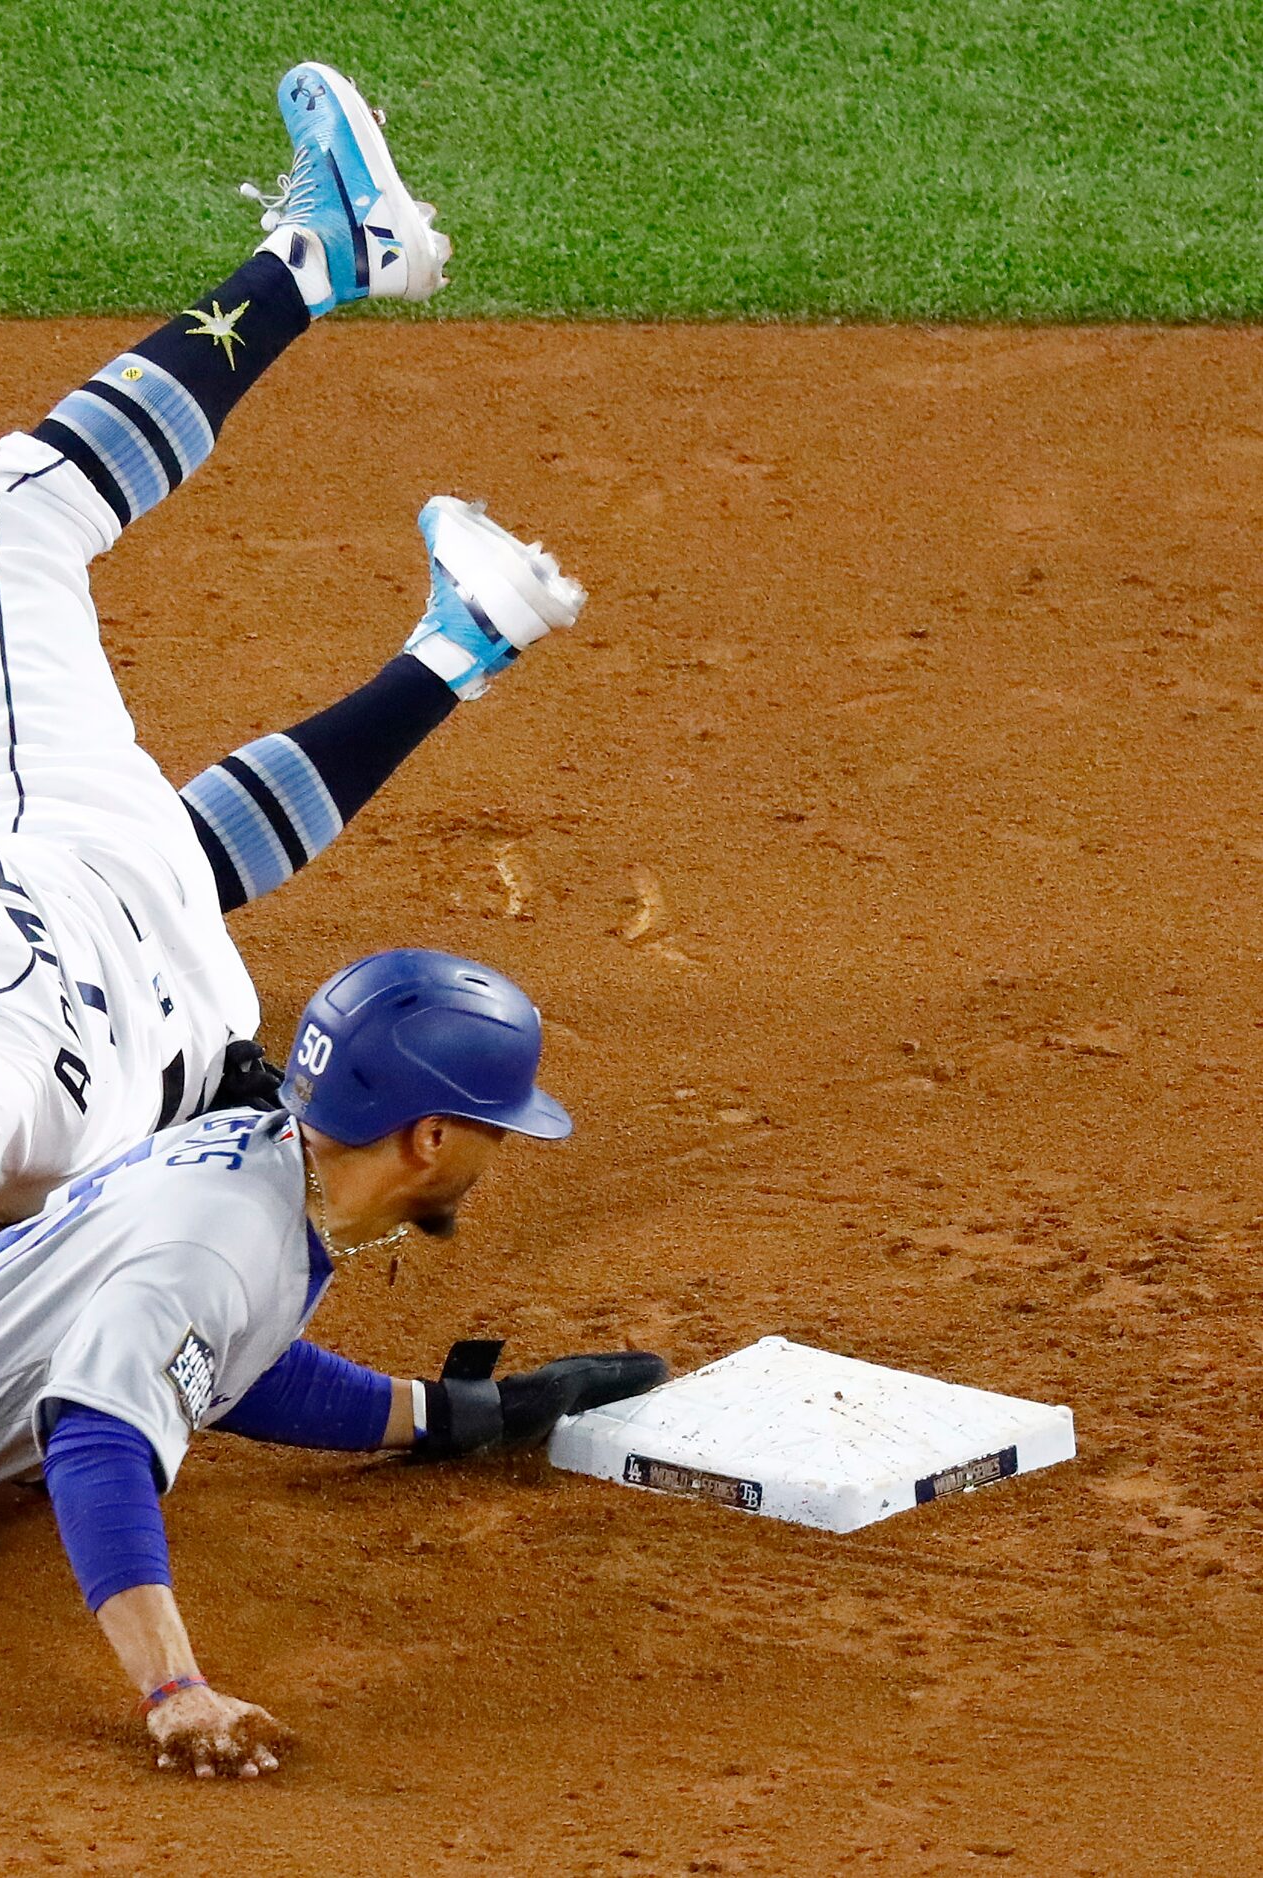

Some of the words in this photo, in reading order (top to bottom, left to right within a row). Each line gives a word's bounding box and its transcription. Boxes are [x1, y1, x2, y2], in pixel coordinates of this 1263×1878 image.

[298, 1023, 333, 1076] 50
[627, 1456, 643, 1482] LA
[739, 1482, 759, 1508] TB
